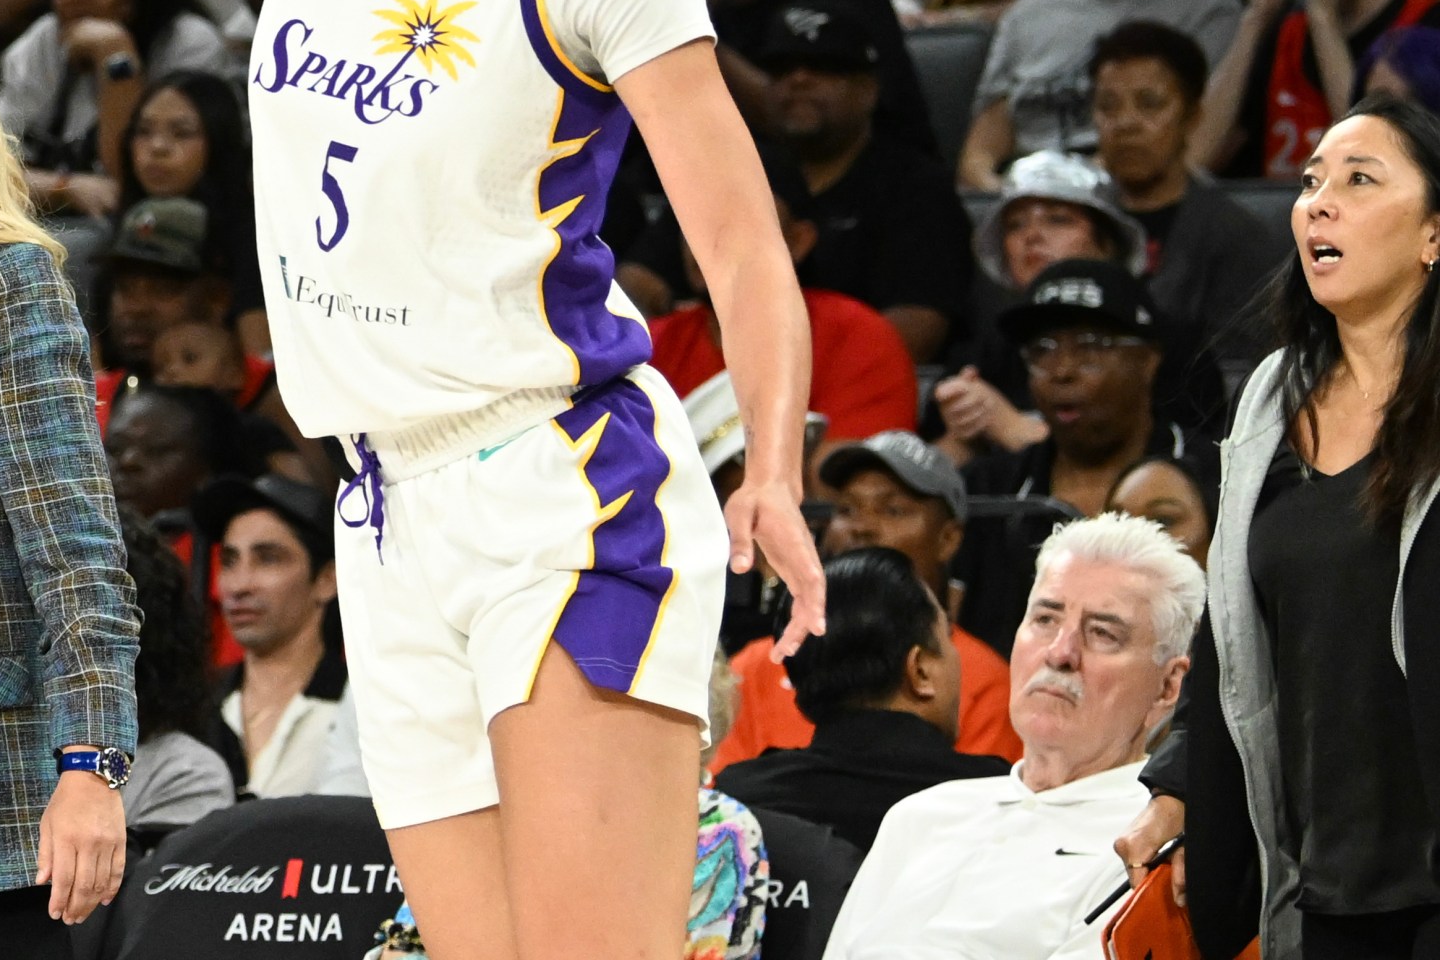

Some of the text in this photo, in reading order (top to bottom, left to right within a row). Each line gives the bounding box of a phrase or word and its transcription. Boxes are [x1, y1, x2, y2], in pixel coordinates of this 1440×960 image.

[316, 140, 359, 253] 5
[144, 863, 280, 895] Michelob
[224, 913, 343, 942] ARENA
